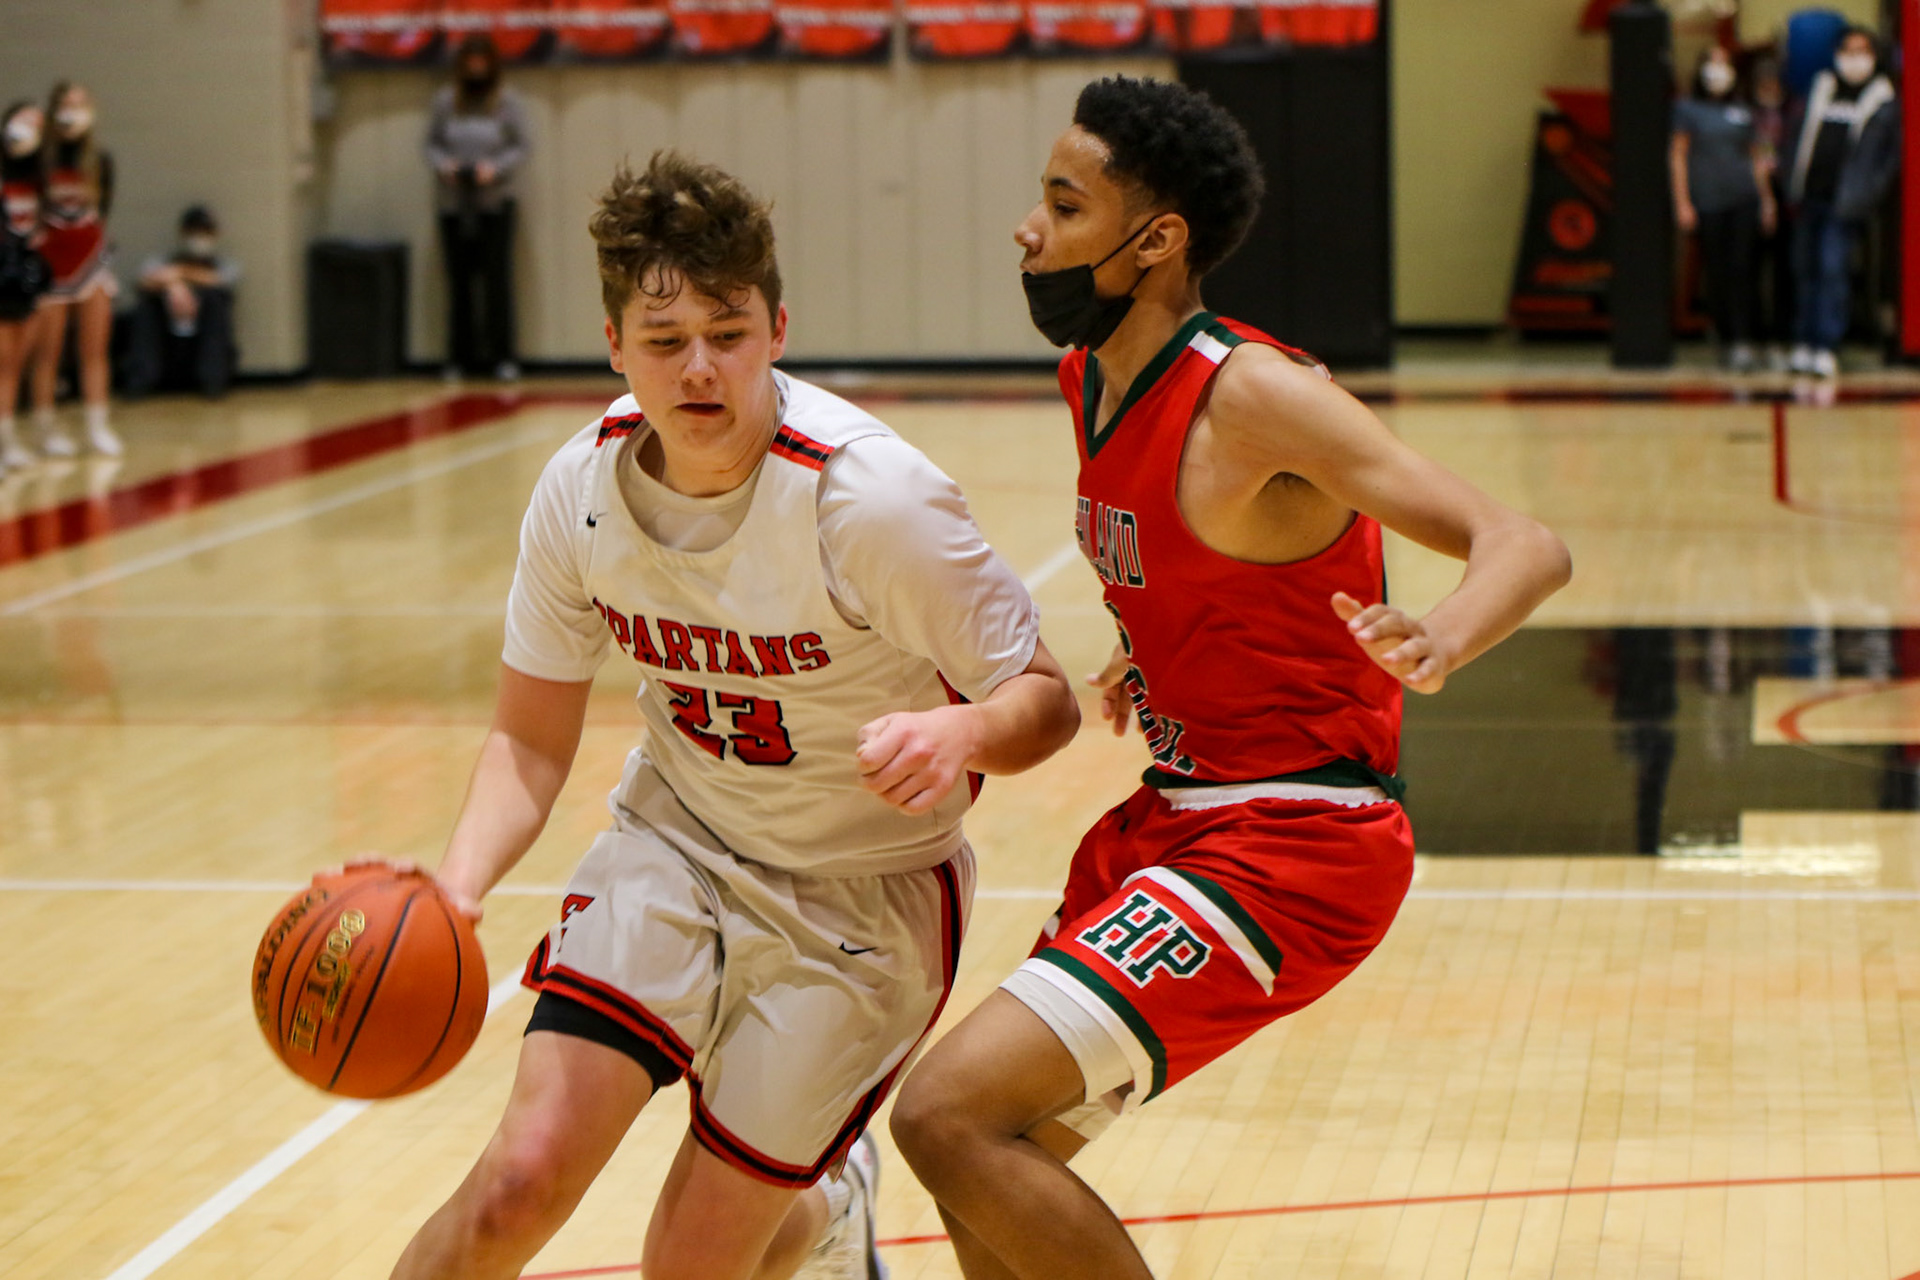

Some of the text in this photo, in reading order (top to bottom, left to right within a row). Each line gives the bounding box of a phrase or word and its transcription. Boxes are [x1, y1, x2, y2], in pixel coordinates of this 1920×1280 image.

[656, 678, 798, 766] 23
[253, 887, 329, 1024] PALDING
[1074, 888, 1213, 989] HP
